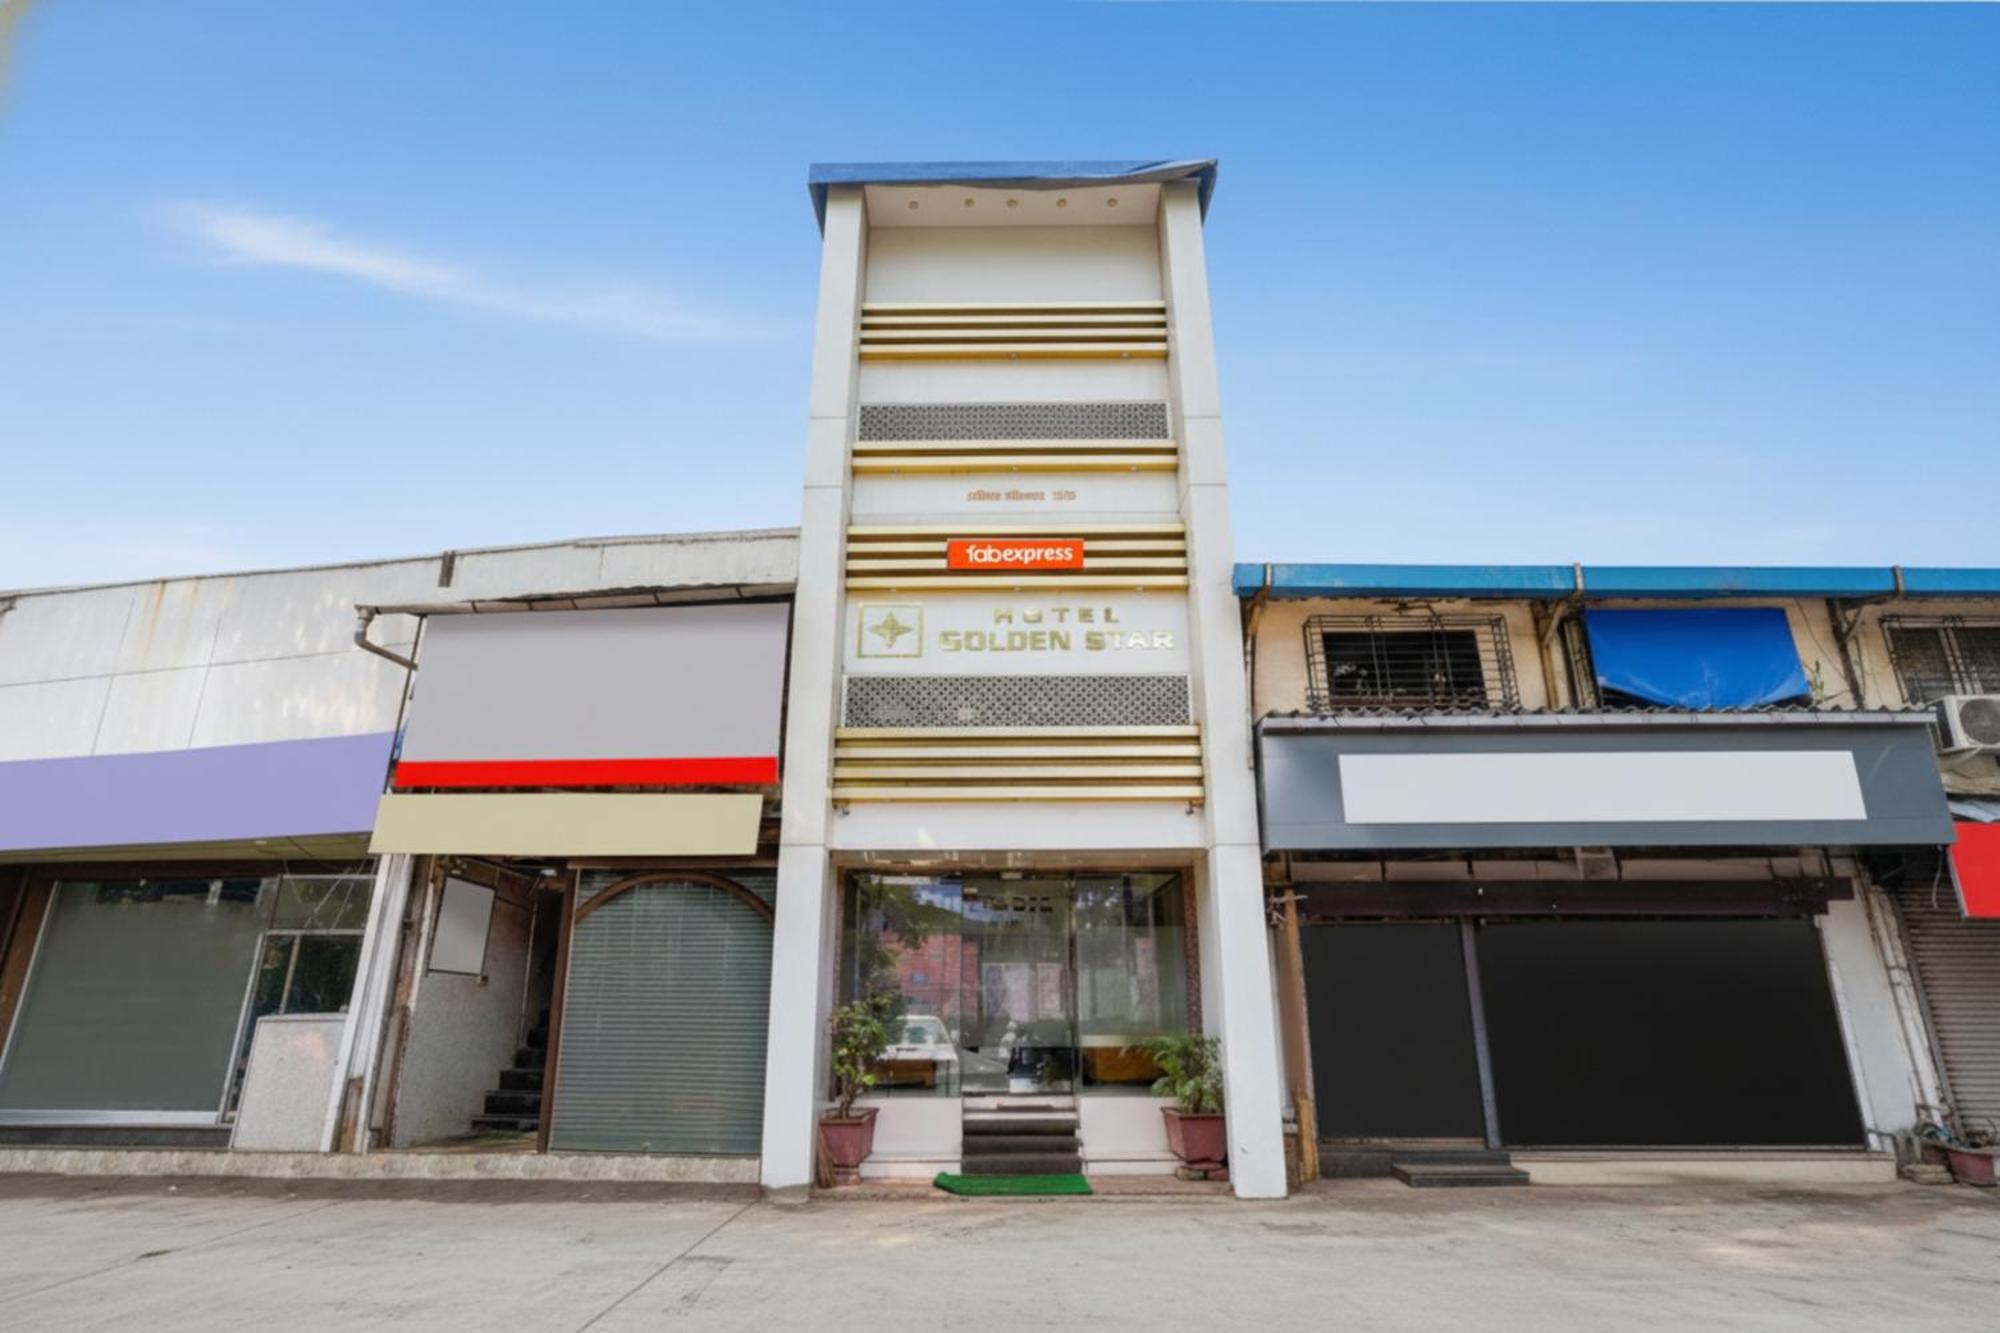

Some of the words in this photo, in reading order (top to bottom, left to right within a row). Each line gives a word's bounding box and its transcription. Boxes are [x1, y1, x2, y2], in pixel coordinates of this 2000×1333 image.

[965, 544, 1073, 564] fabexpress
[993, 607, 1120, 625] HOTEL
[939, 630, 1071, 651] GOLDEN
[1085, 630, 1175, 651] STAR
